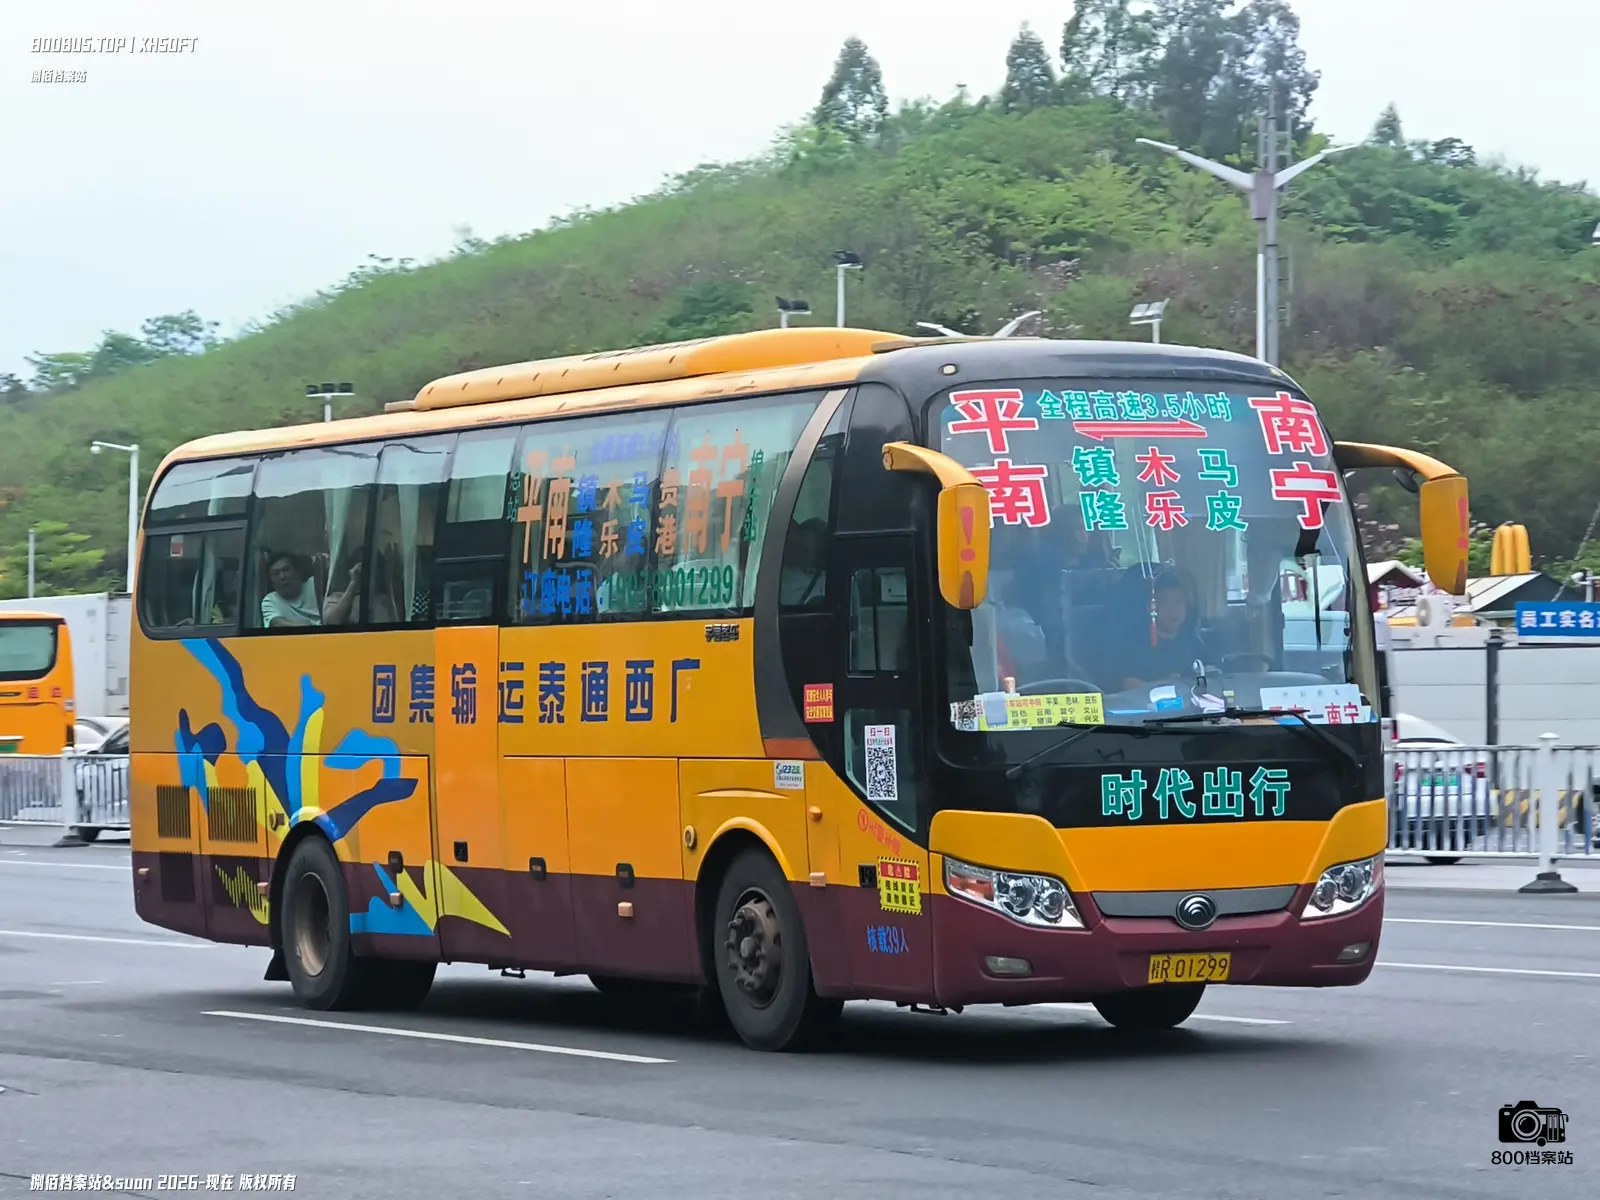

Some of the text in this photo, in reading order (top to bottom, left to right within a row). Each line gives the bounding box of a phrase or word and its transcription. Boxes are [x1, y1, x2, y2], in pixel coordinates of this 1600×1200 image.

[1036, 390, 1232, 421] 全程高速3.5小时
[948, 388, 1049, 528] 平南
[1072, 446, 1128, 531] 镇隆
[1136, 446, 1188, 531] 木乐
[1197, 447, 1248, 532] 马皮
[1248, 392, 1342, 530] 南宁
[1521, 610, 1600, 629] 员工实名
[1101, 766, 1292, 821] 时代出行
